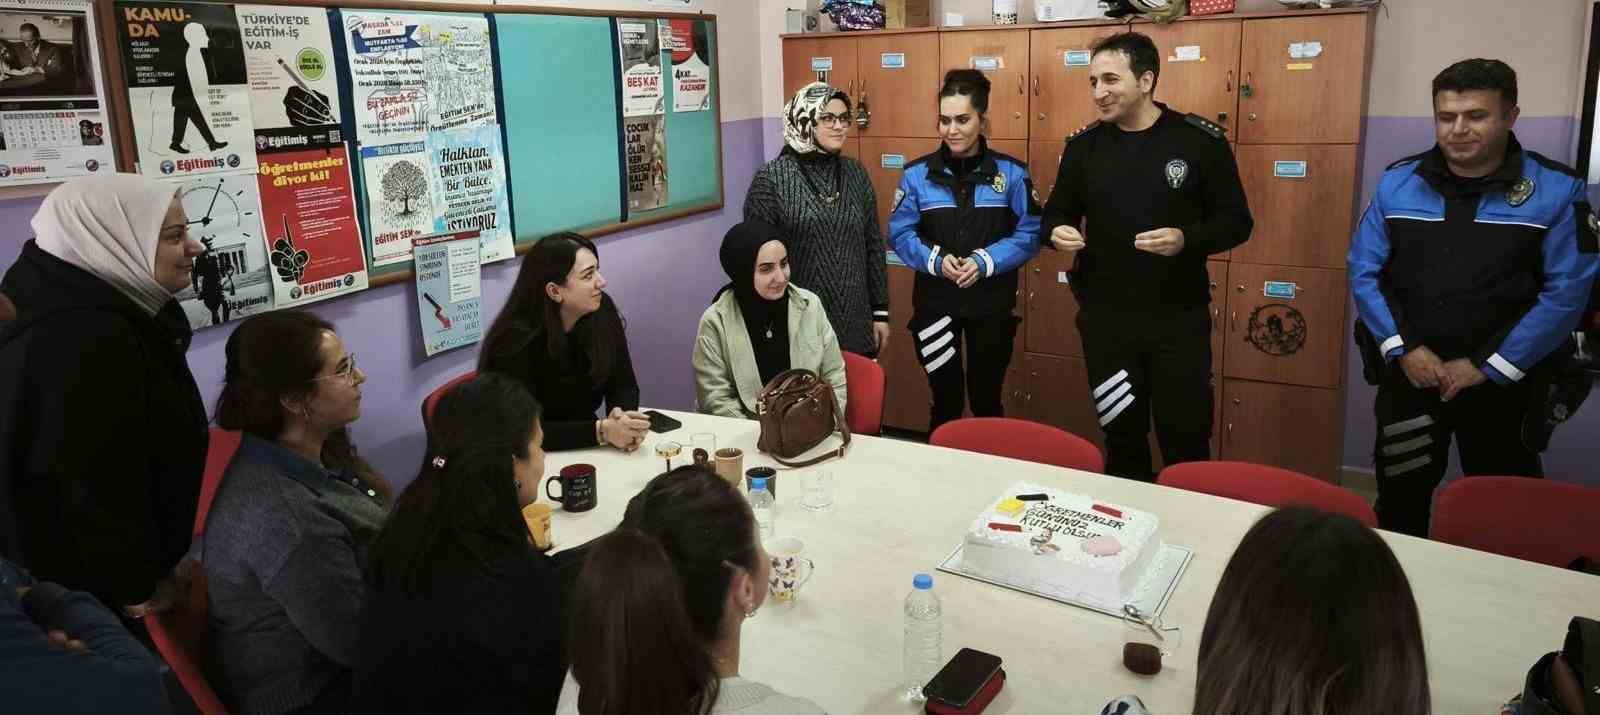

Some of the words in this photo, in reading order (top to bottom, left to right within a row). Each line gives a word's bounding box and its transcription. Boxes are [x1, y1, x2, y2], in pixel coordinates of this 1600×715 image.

[125, 7, 192, 22] KAMU-
[242, 13, 310, 25] TÜRKİYE'DE
[128, 23, 160, 38] DA
[244, 26, 300, 40] EĞİTİM-İŞ
[246, 41, 271, 50] VAR
[643, 76, 659, 87] KAT
[628, 134, 641, 144] LAR
[176, 156, 225, 172] Eğitimiş
[439, 162, 473, 178] EMEKTEN
[474, 159, 493, 172] YANA
[273, 174, 308, 187] diyor
[445, 180, 460, 192] Bir
[375, 232, 399, 245] EĞİTİM
